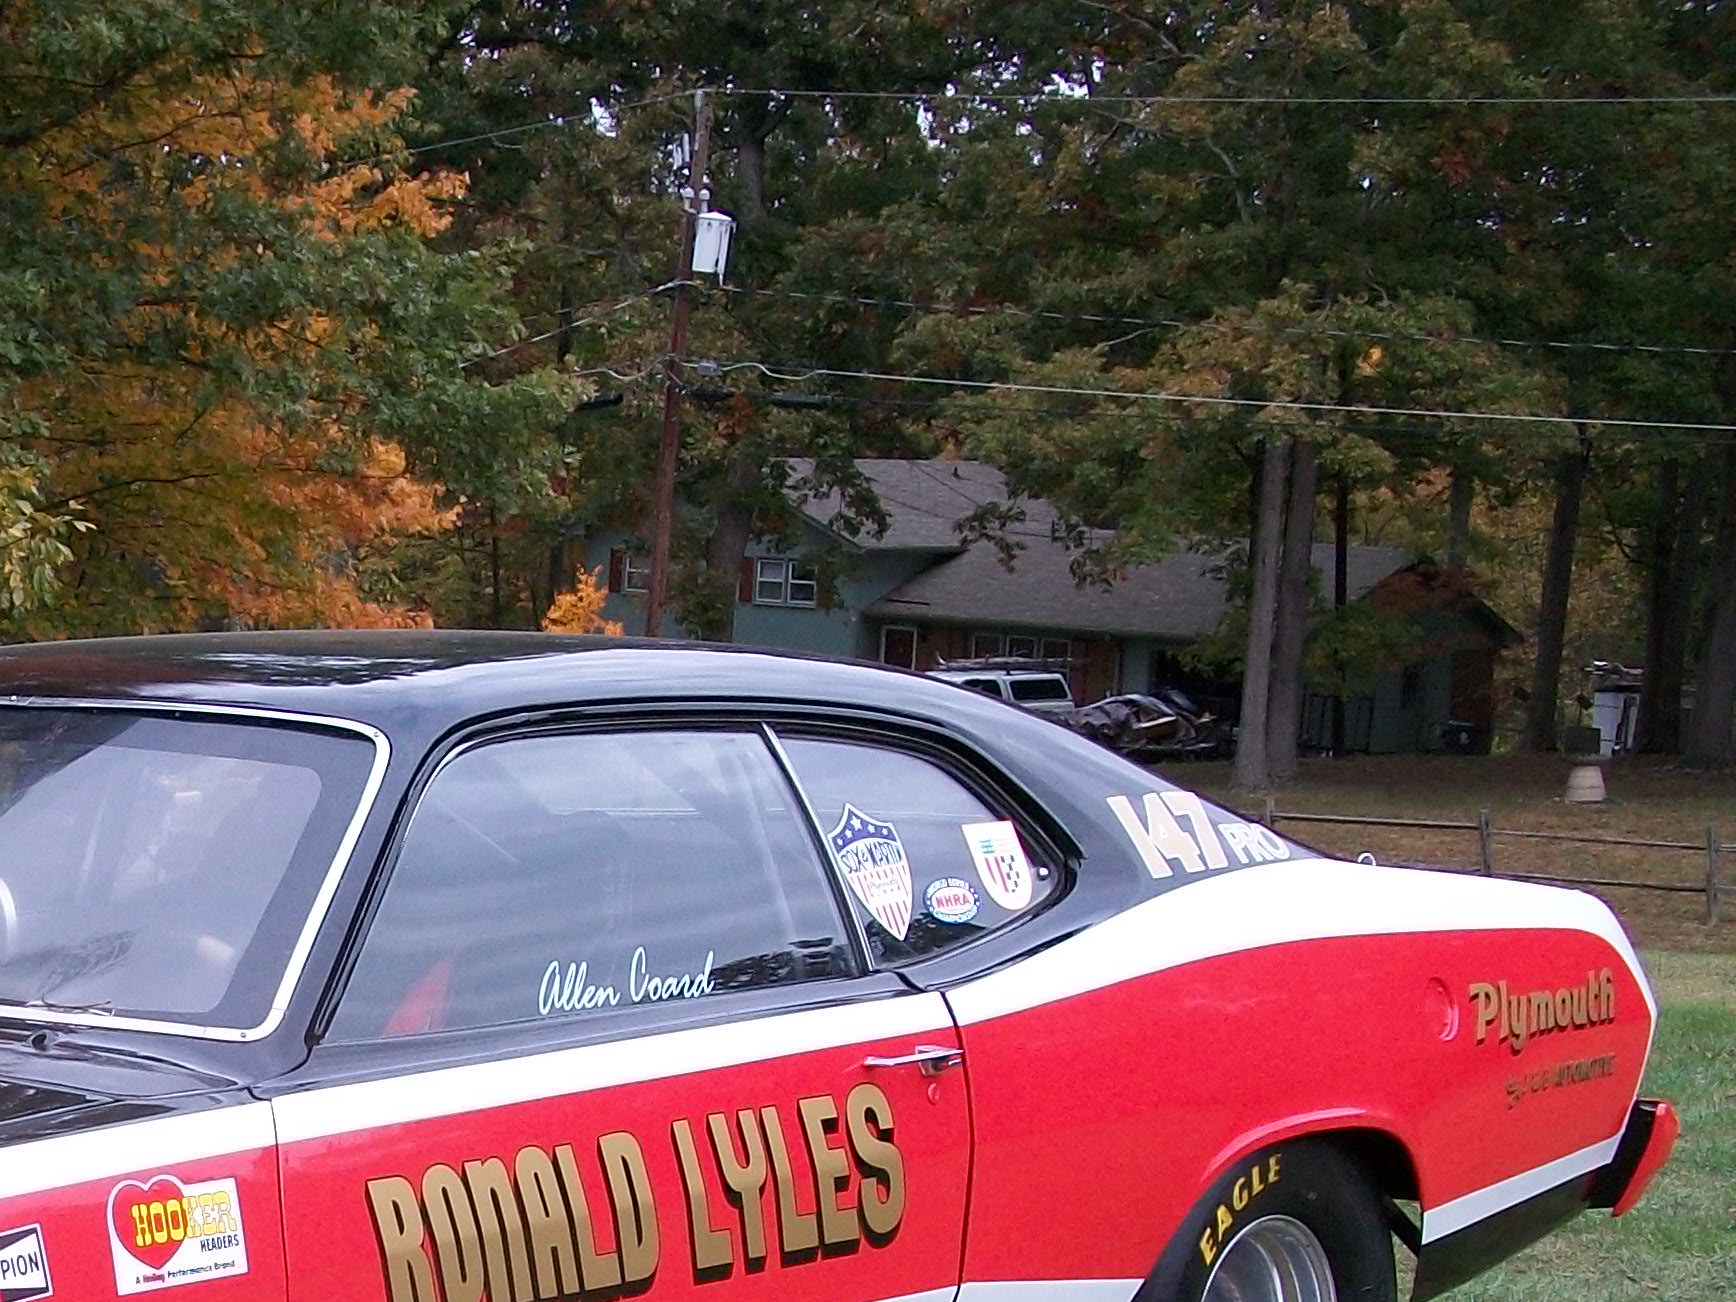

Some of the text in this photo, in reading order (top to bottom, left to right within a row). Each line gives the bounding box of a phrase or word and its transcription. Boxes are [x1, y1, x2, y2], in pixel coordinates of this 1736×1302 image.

[1106, 792, 1290, 878] 147 PRO
[935, 893, 972, 908] NHRA
[539, 946, 714, 1015] Allen Coard
[1469, 967, 1615, 1056] Plymouth
[131, 1190, 238, 1248] HOOKER
[671, 1083, 905, 1286] LYLES
[1198, 1153, 1282, 1267] EAGLE
[200, 1234, 240, 1253] HEADERS
